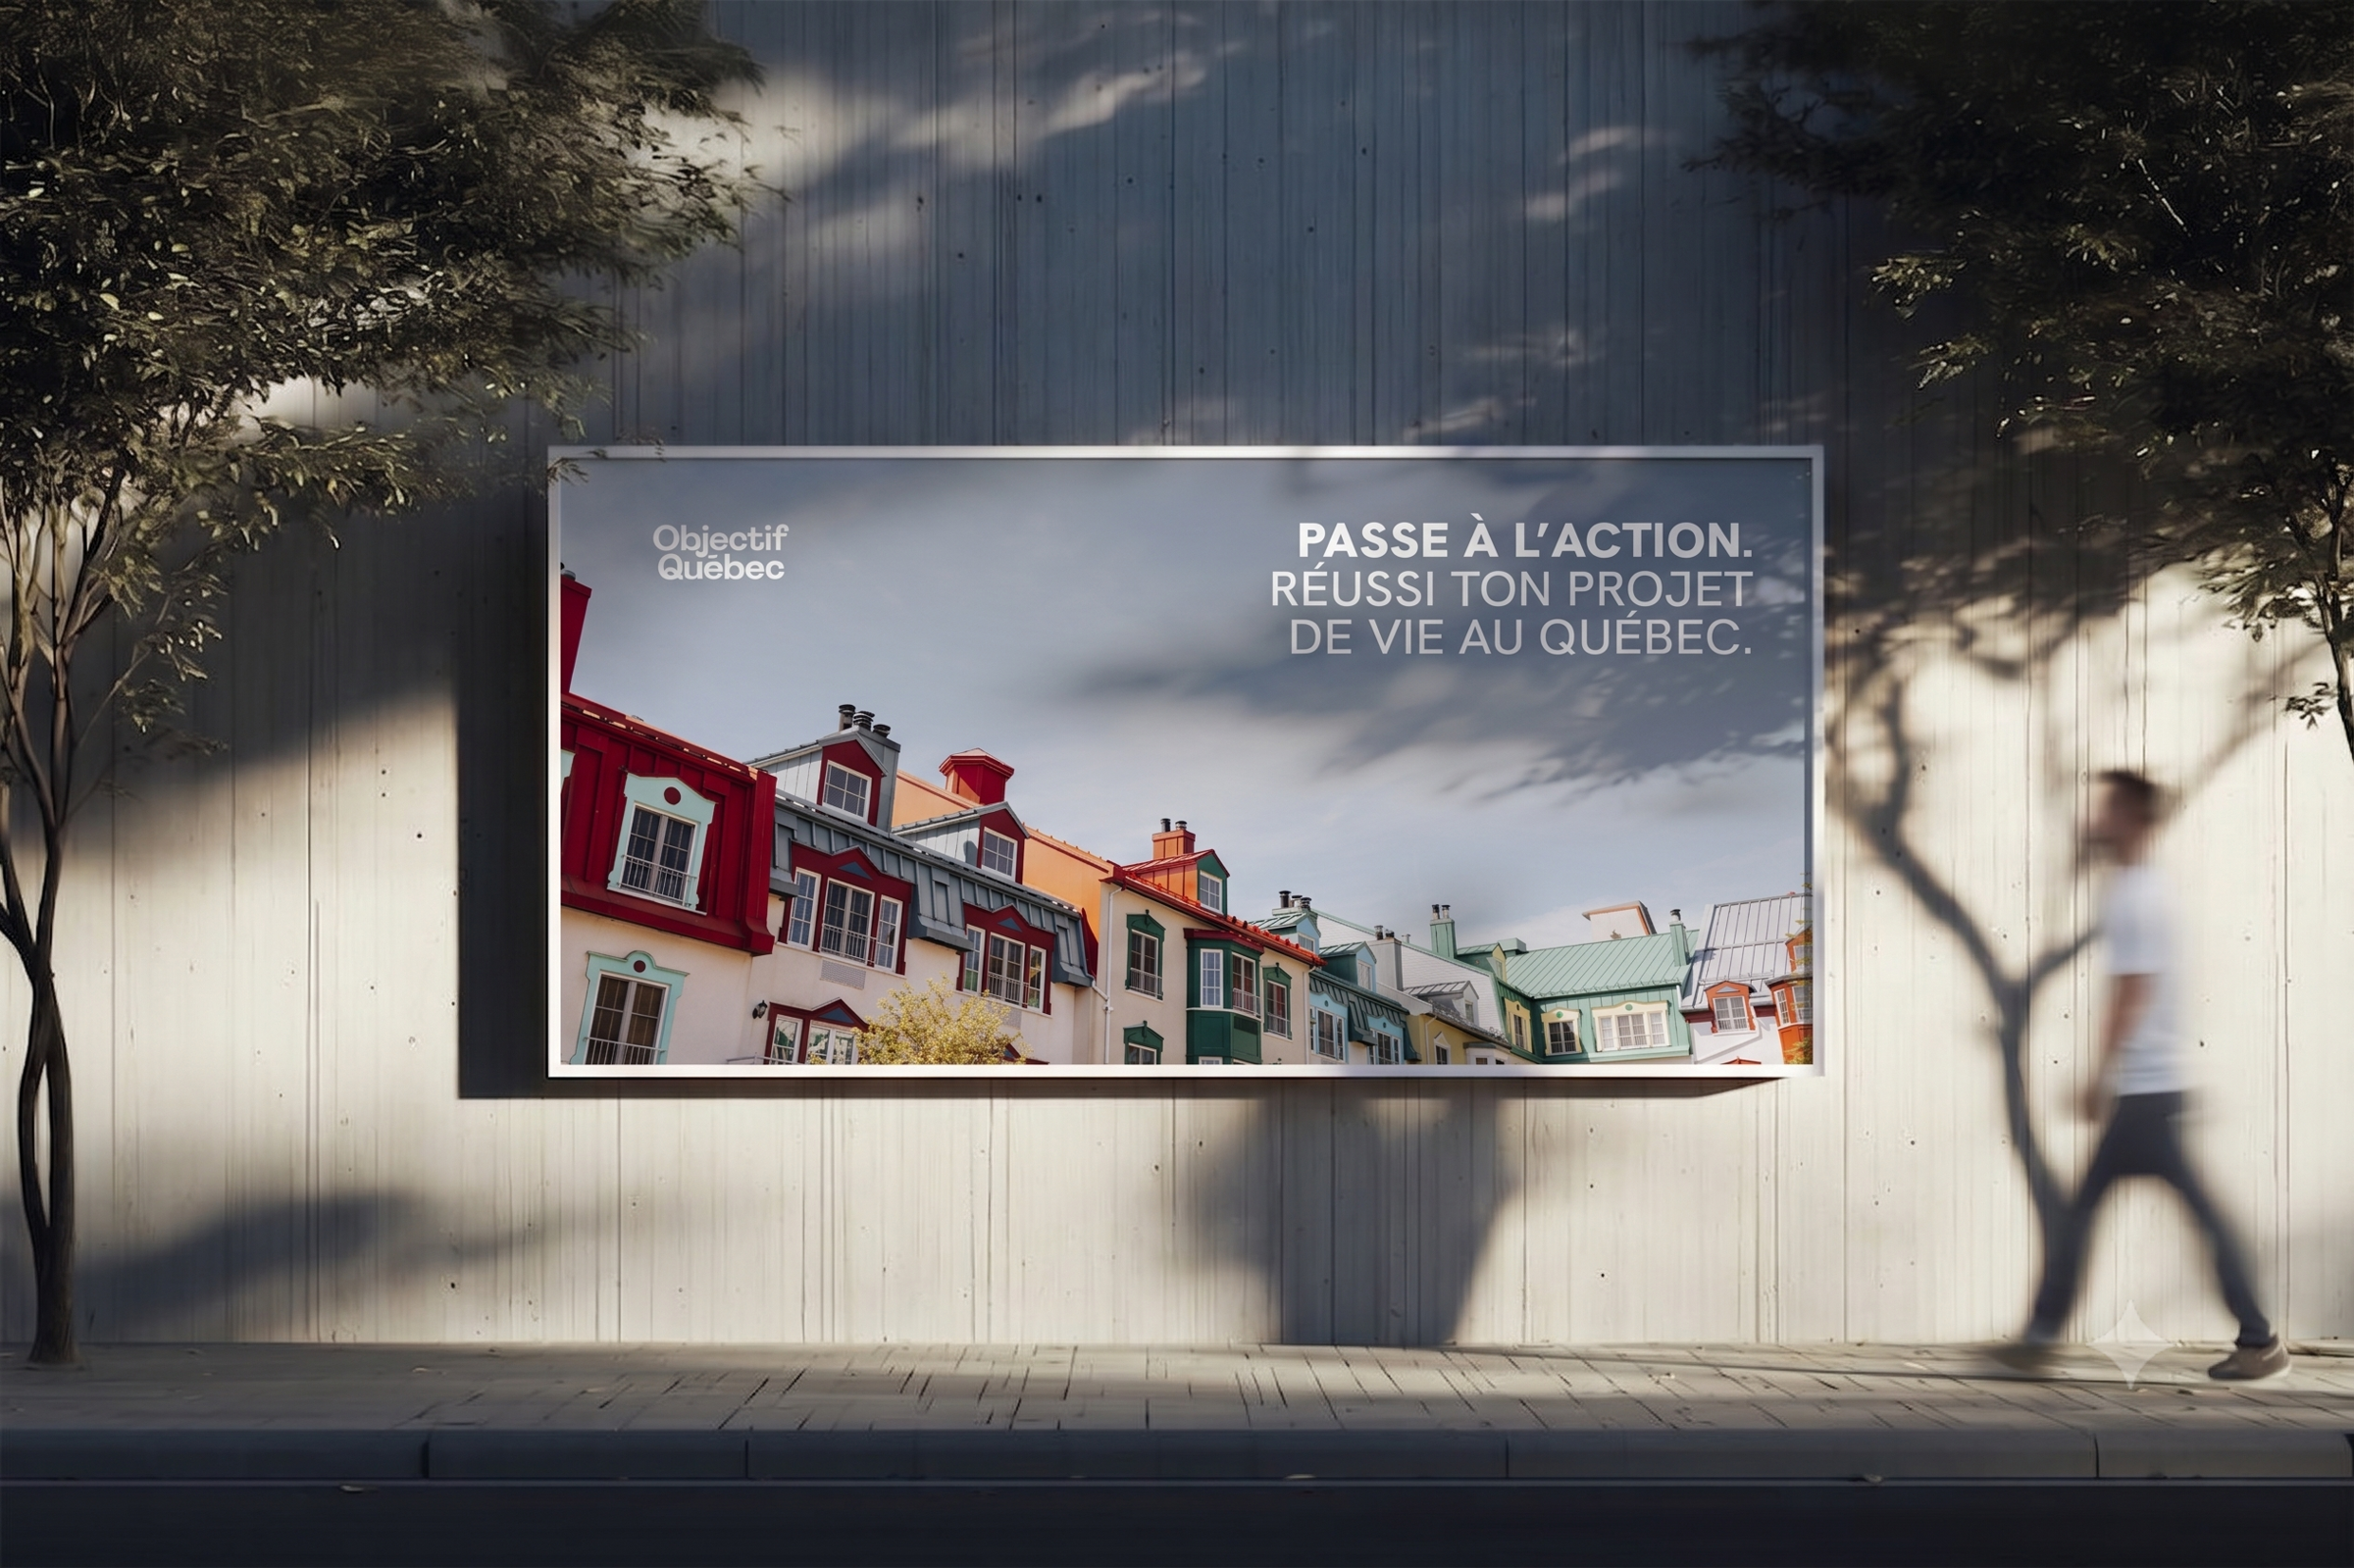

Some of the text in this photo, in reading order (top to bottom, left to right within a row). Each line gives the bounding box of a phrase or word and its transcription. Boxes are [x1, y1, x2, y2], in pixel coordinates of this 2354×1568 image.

[652, 524, 790, 558] Objectif
[1298, 513, 1753, 559] PASSE À L’ACTION.
[657, 553, 785, 581] Québec
[1272, 562, 1754, 607] RÉUSSI TON PROJET
[1291, 610, 1752, 655] DE VIE AU QUÉBEC.
